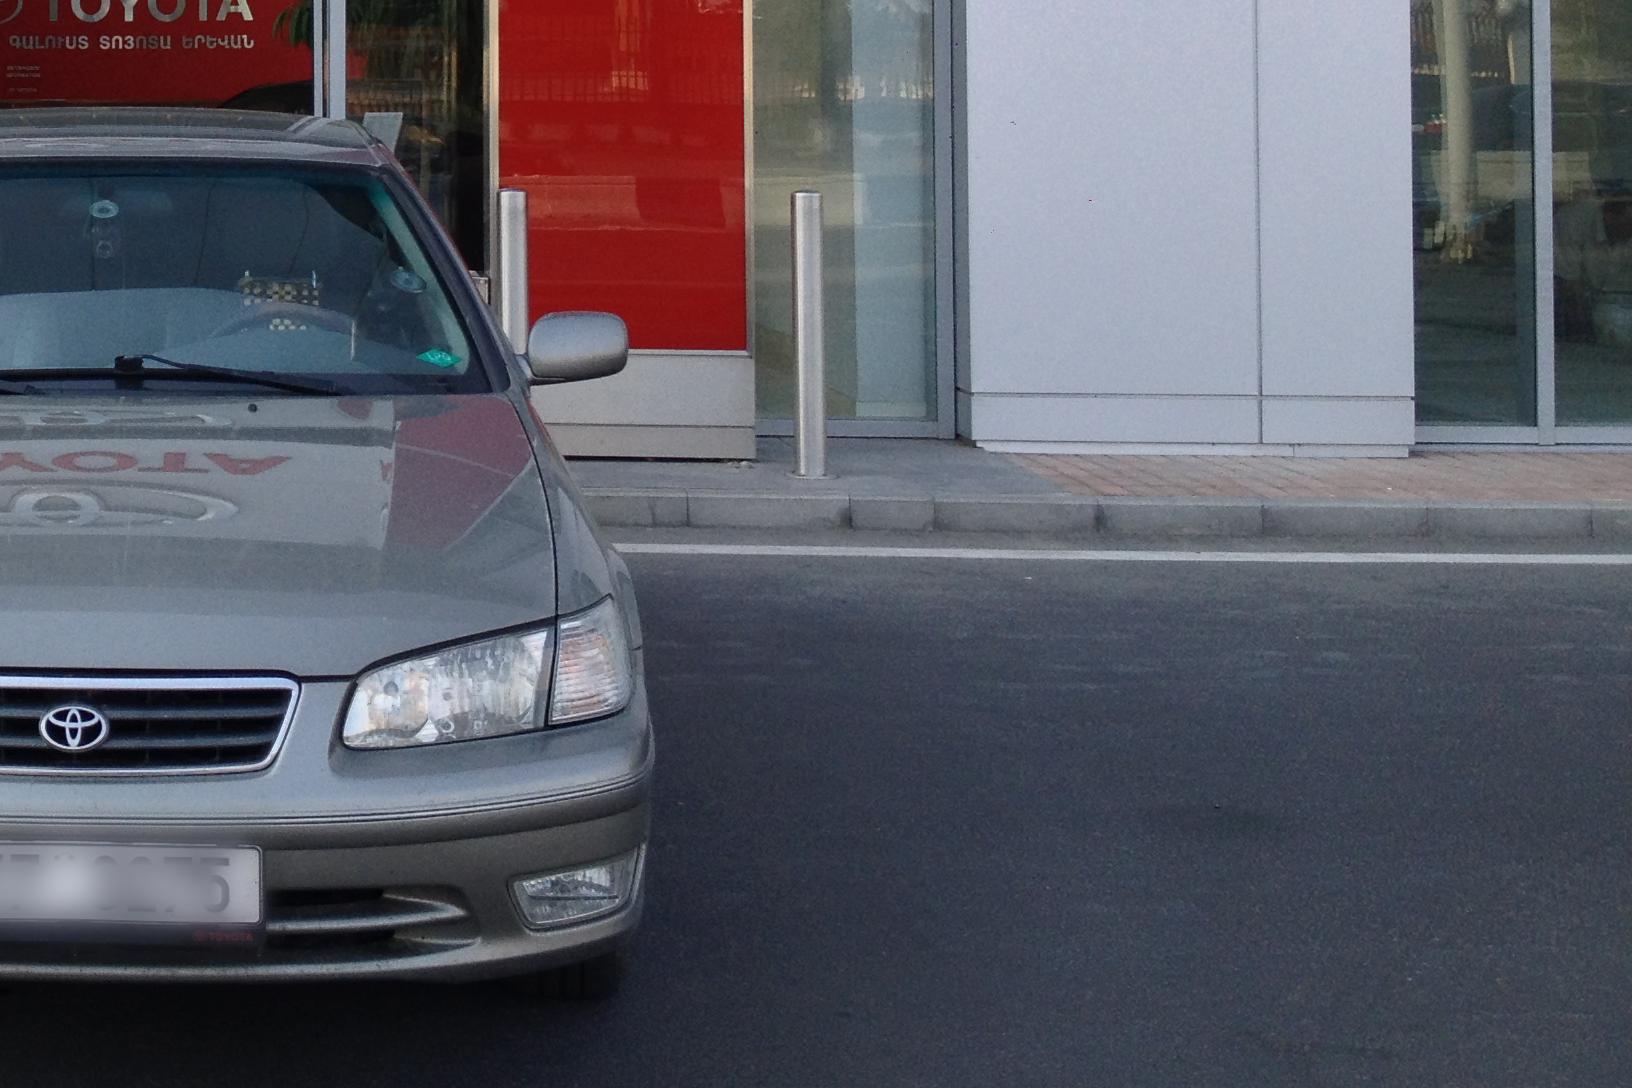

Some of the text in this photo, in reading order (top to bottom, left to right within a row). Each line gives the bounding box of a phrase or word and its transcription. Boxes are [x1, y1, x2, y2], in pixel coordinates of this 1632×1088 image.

[9, 35, 89, 50] ԳԱԼՈՒՍՏ
[98, 35, 172, 50] ՏՈՅՈՏԱ
[181, 34, 255, 49] ԵՐԵՎԱՆ
